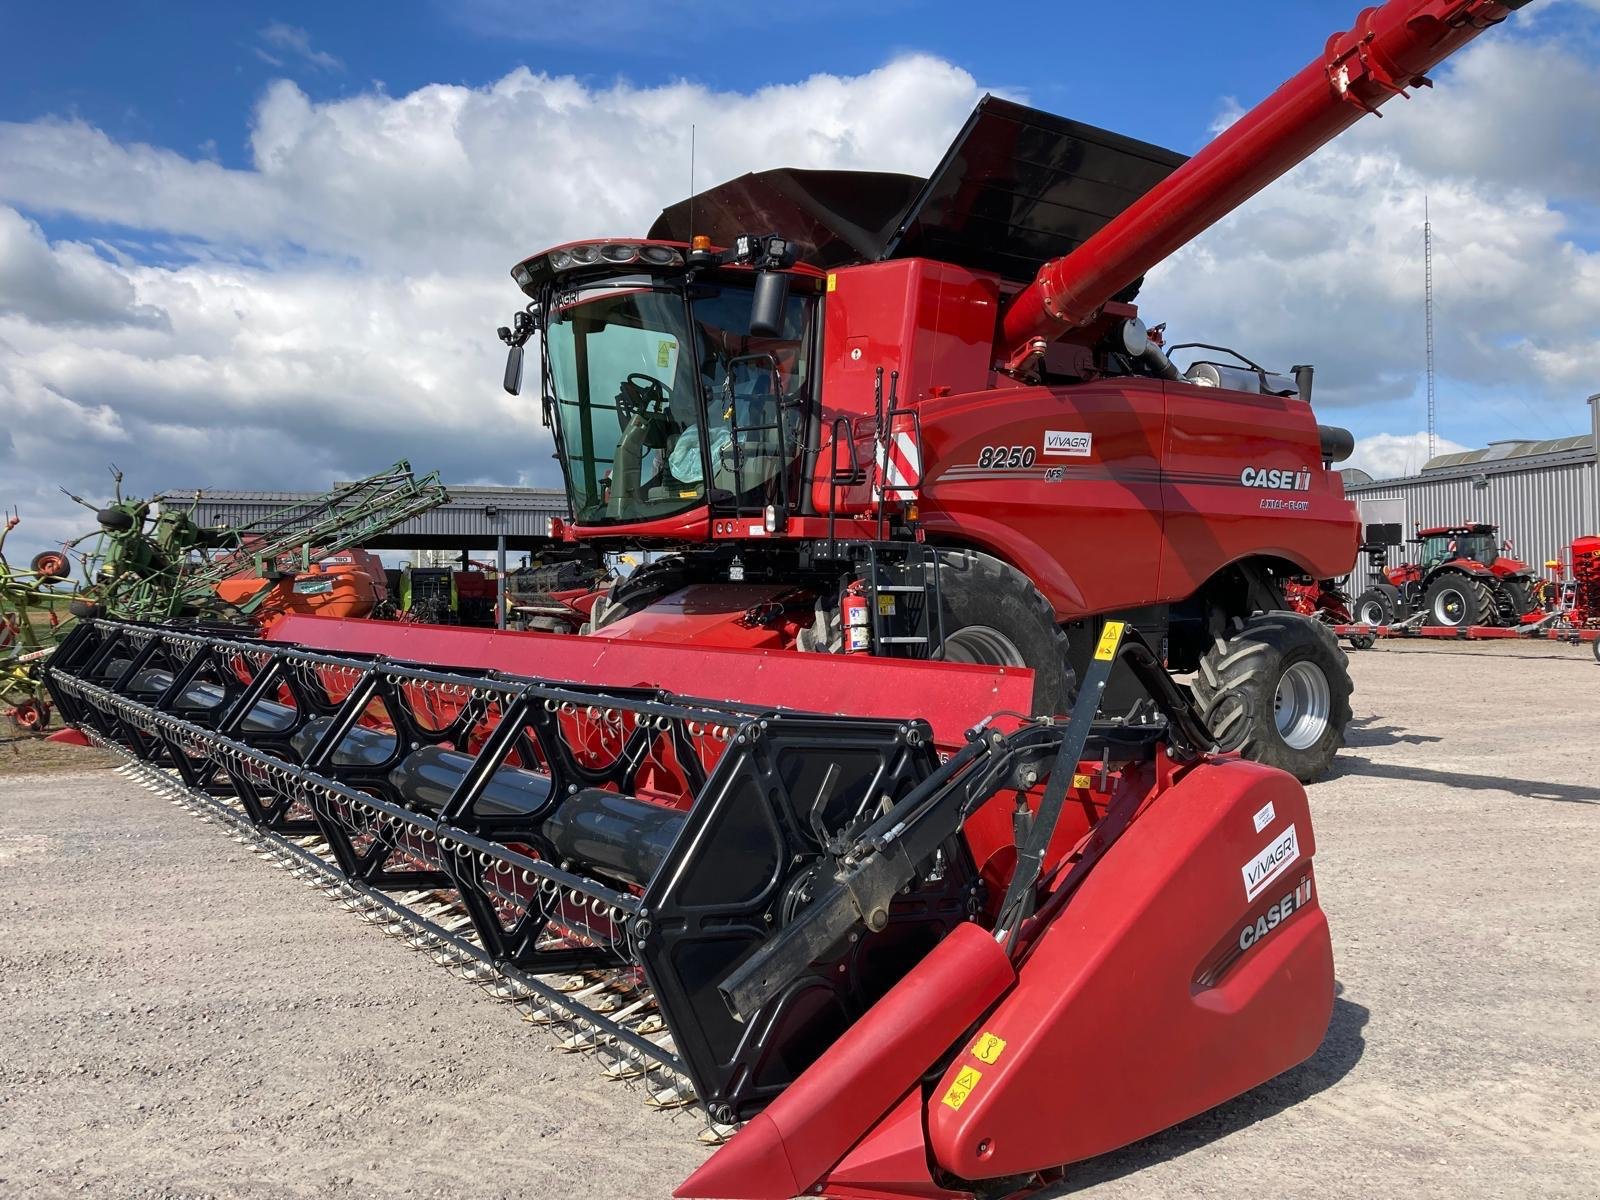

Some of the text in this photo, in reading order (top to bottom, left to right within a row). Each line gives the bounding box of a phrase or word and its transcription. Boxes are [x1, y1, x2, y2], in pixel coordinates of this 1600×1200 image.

[978, 445, 1036, 469] 8250
[1241, 466, 1293, 490] CASE
[1260, 498, 1309, 511] AXIAL-FLOW
[1239, 892, 1293, 950] CASE
